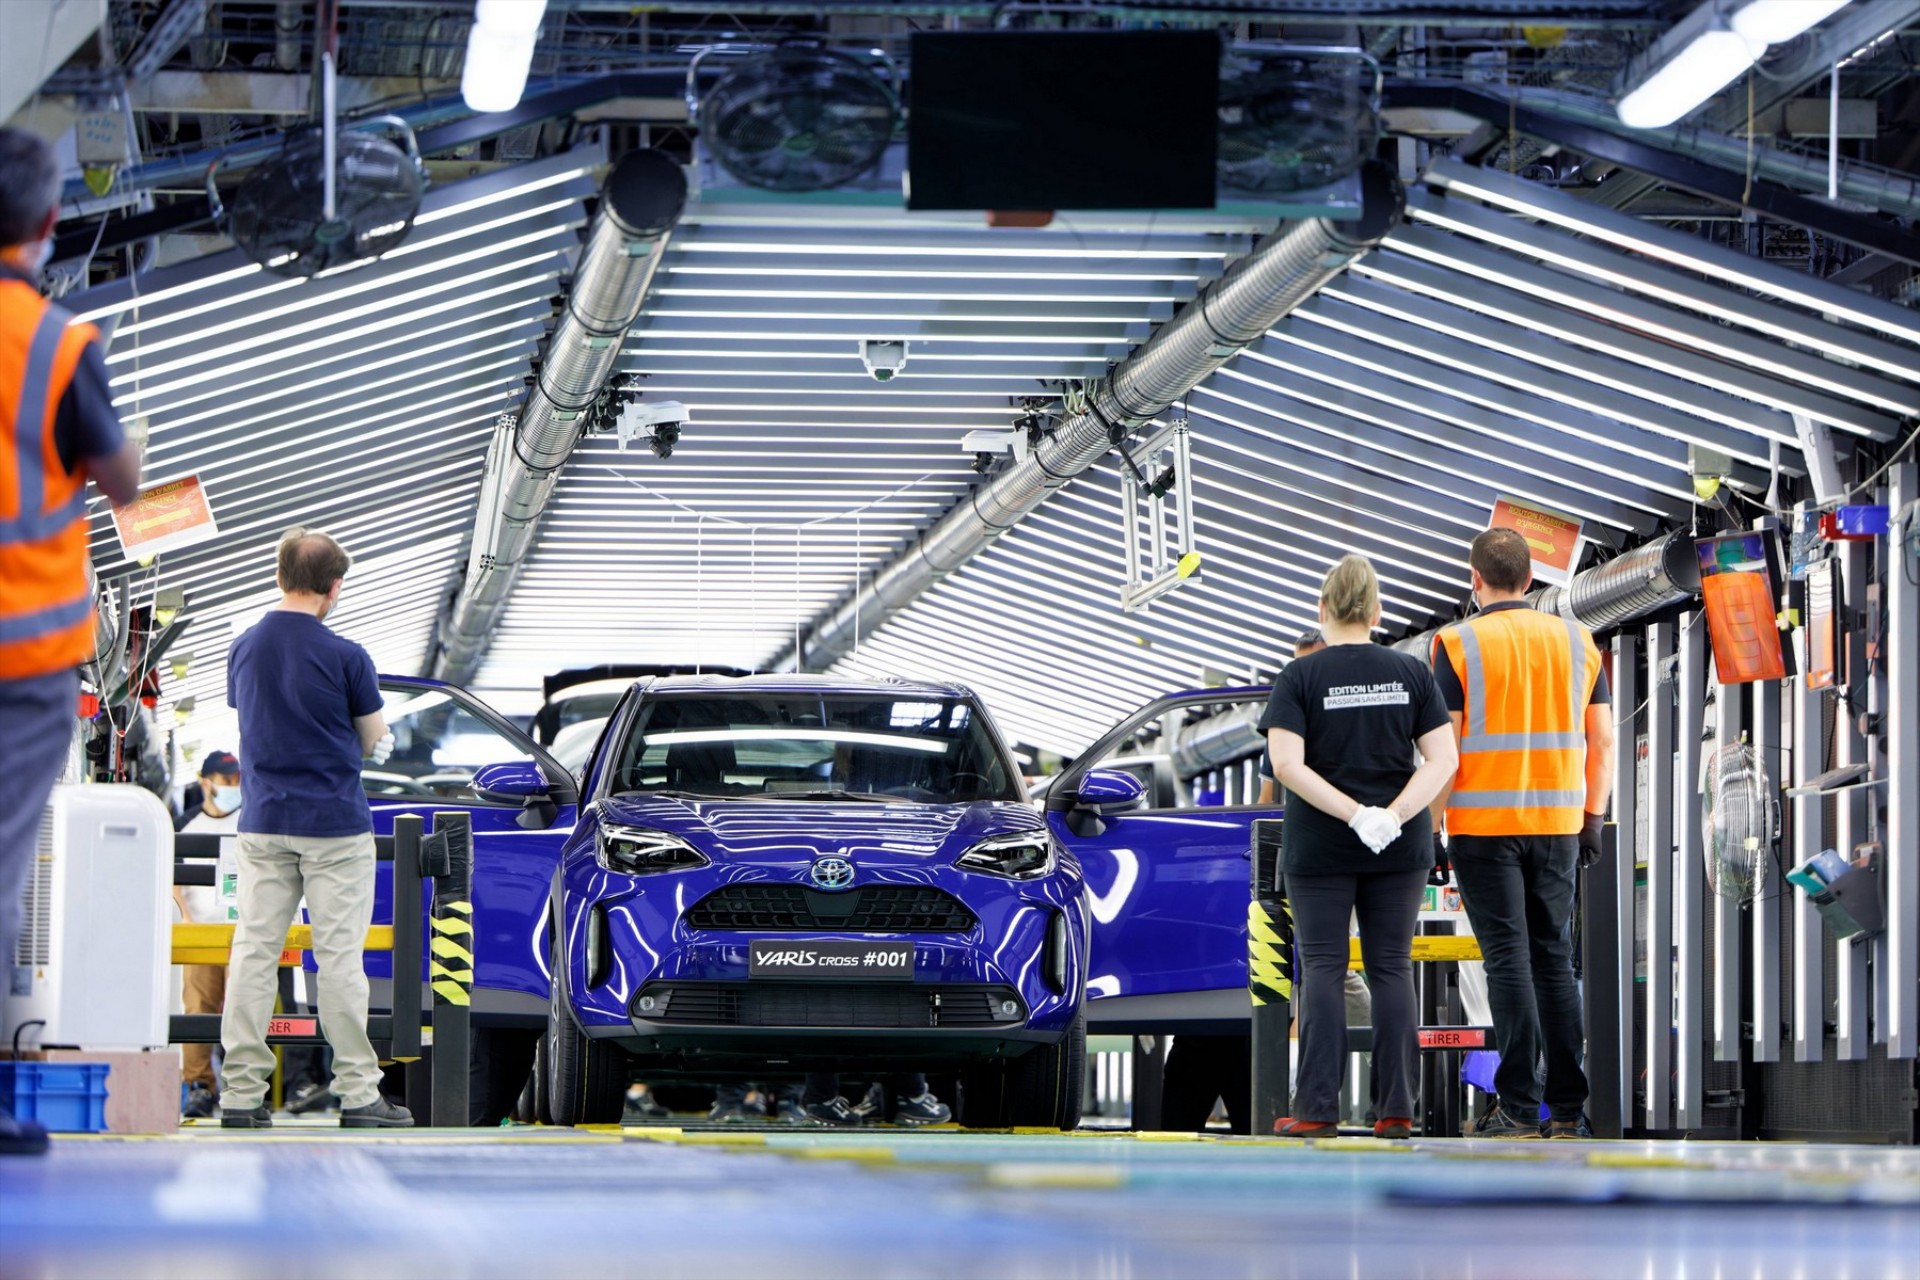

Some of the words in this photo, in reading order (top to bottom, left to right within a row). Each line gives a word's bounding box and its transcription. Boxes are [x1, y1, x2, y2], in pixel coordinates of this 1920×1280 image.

[1509, 505, 1537, 519] BOUTON
[1328, 685, 1366, 697] EDITION
[1367, 681, 1404, 693] LIMITÉE
[1327, 697, 1360, 706] PASSION
[1361, 695, 1381, 703] SANS
[818, 956, 859, 966] CROSS
[863, 952, 907, 966] #001
[1427, 1033, 1460, 1044] TIRER
